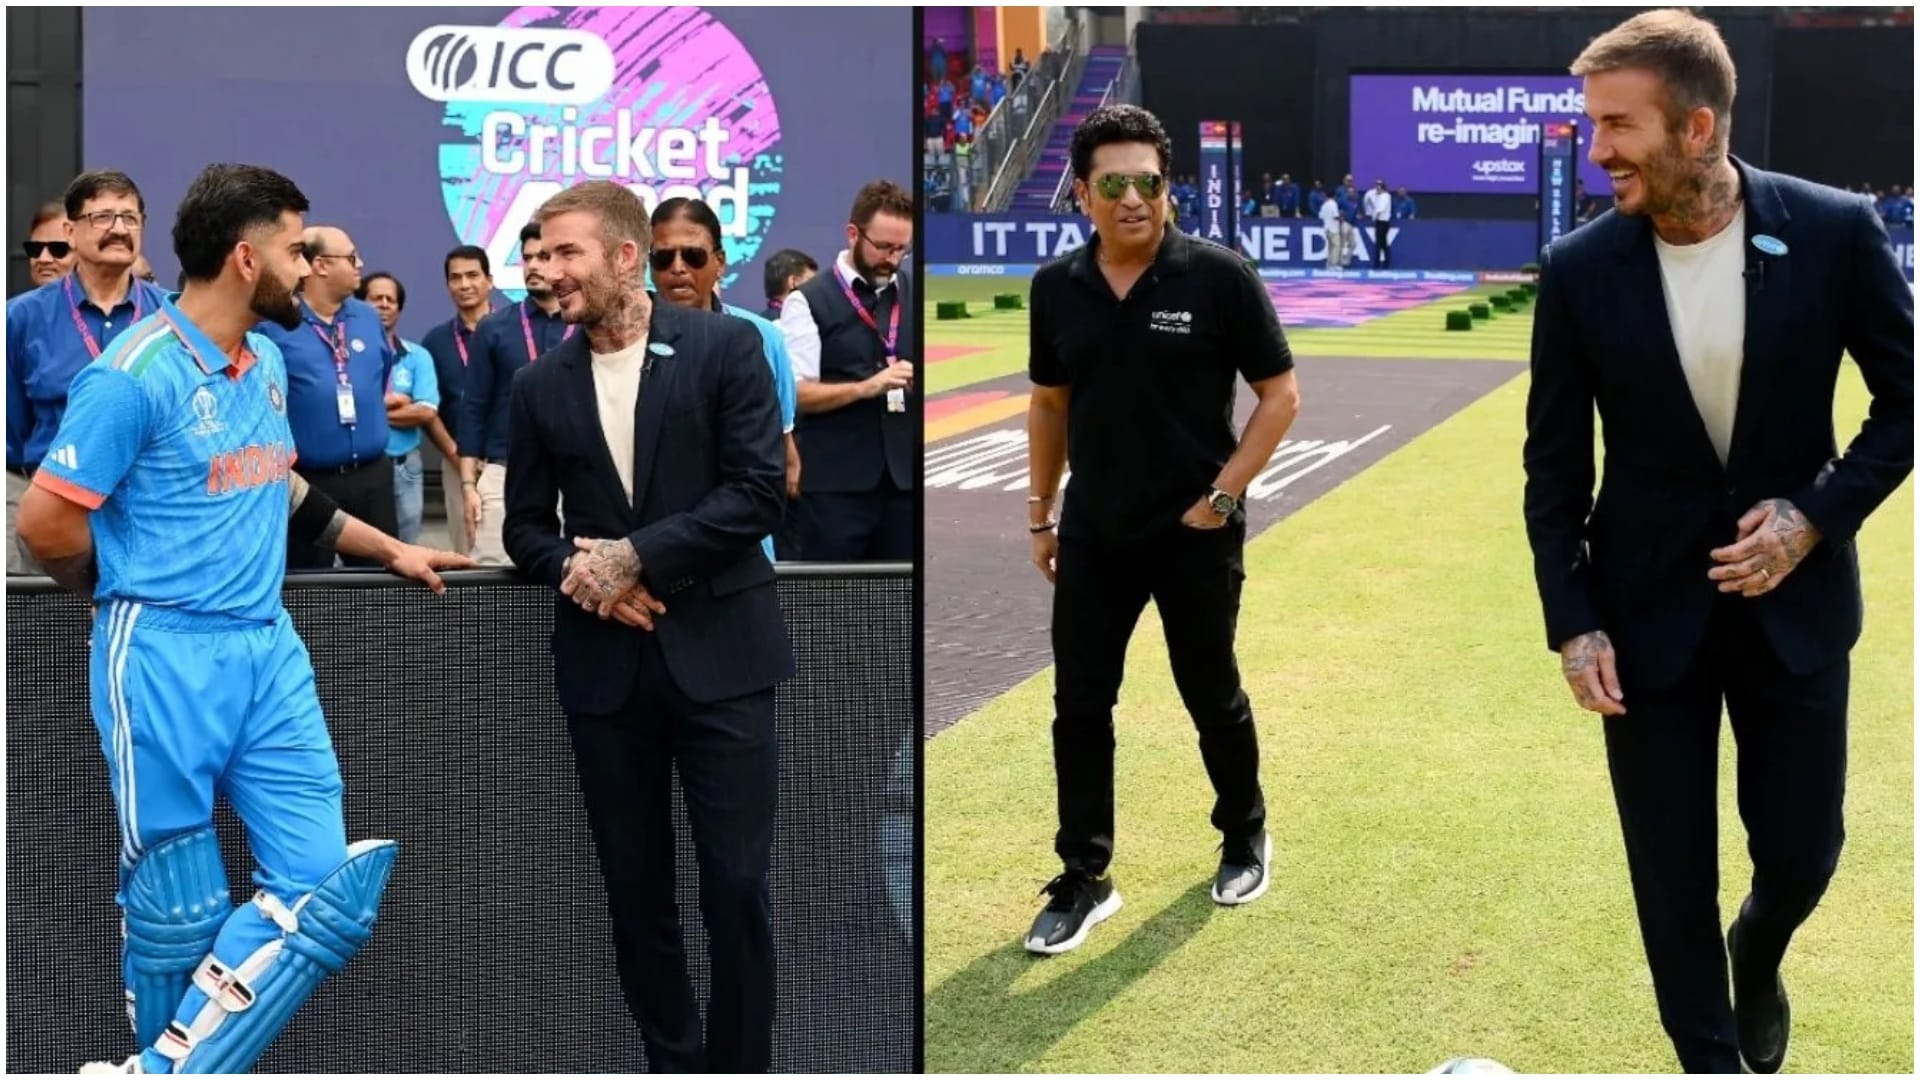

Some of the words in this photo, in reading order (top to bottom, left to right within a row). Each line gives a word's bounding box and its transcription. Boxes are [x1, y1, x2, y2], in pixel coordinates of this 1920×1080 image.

[488, 41, 583, 91] ICC
[1412, 86, 1504, 113] Mutual
[1508, 87, 1586, 114] Funds
[482, 107, 731, 180] Cricket
[1472, 158, 1526, 176] upstox
[1207, 164, 1223, 239] INDIA
[972, 221, 1017, 257] IT
[957, 264, 1005, 275] aramco
[1151, 309, 1181, 321] unicef
[207, 441, 291, 496] INDIA
